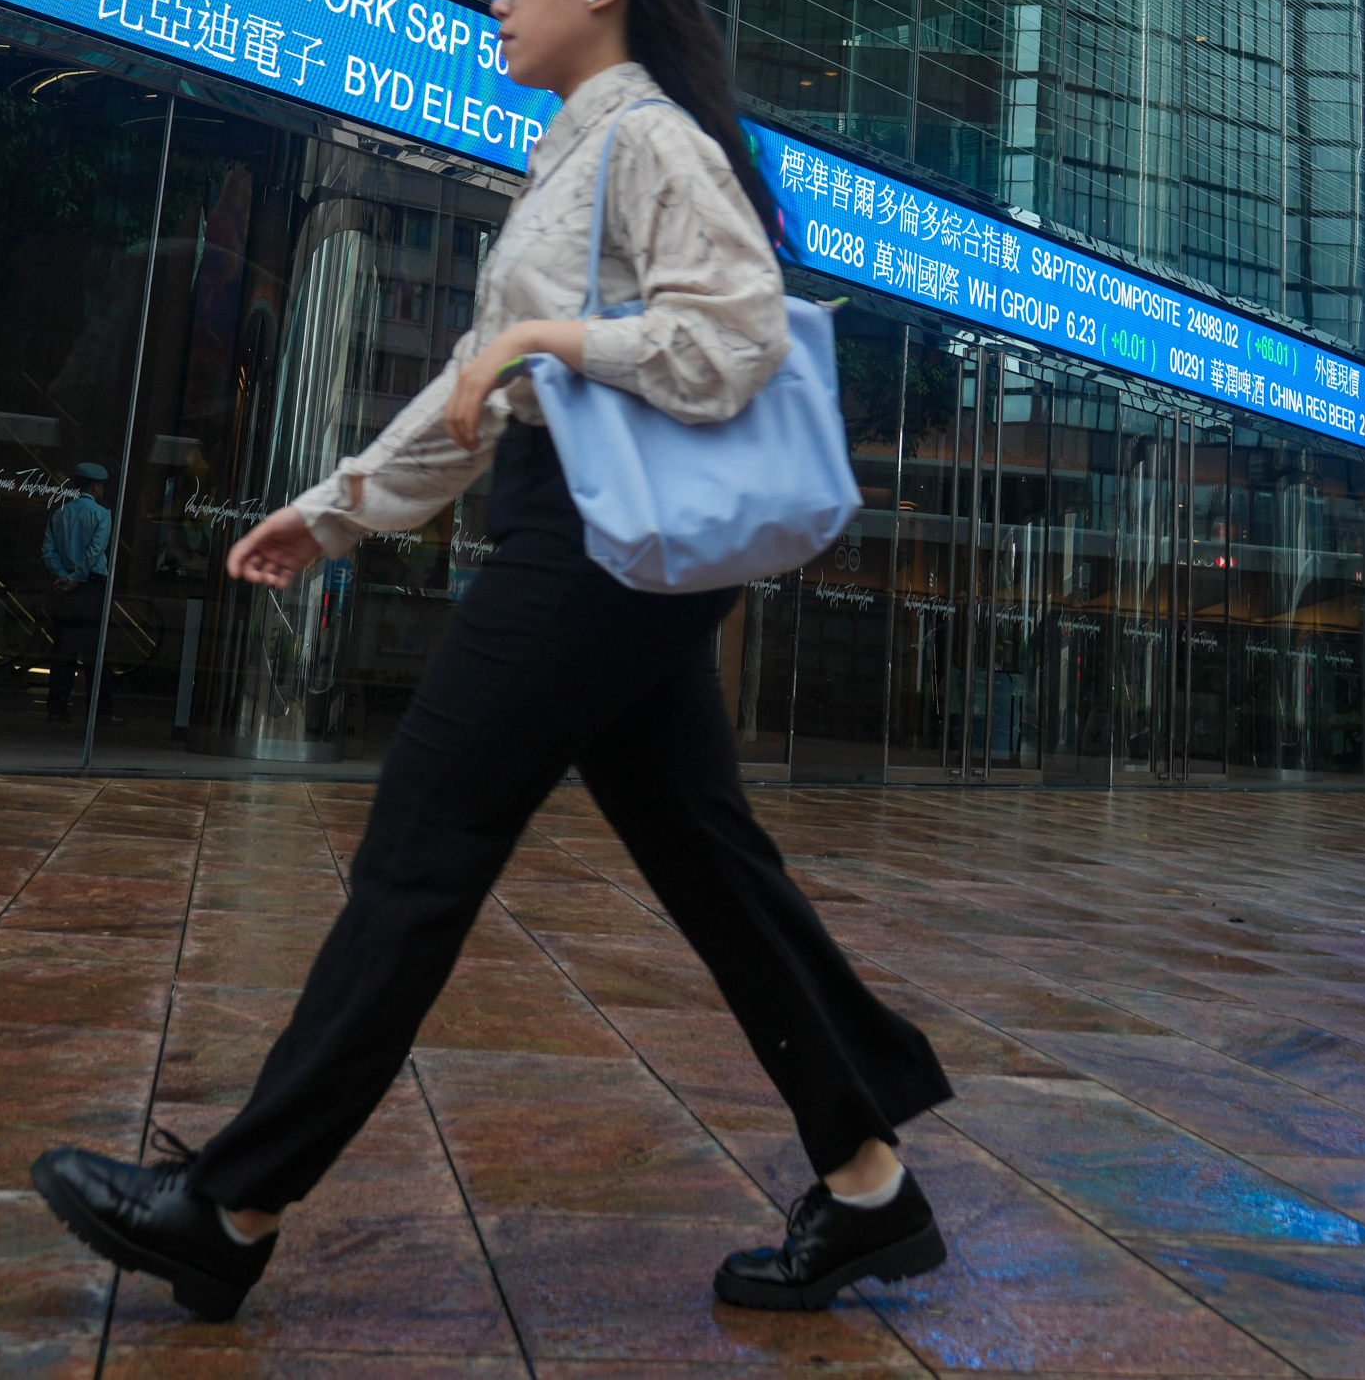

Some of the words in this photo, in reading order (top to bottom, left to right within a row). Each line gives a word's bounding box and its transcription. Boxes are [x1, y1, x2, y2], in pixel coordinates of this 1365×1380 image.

[344, 53, 415, 112] BYD
[405, 2, 471, 56] S&P
[778, 143, 1021, 275] 標準普爾多倫多綜合指數
[1031, 246, 1097, 297] S&P/TSX
[1099, 272, 1182, 329] COMPOSITE
[1186, 306, 1240, 349] 24989.02
[1254, 336, 1290, 367] +66.01
[1314, 352, 1361, 400] 外匯現價
[806, 219, 866, 270] 00288
[872, 238, 961, 306] 萬洲國際
[967, 275, 998, 313] WH
[1000, 287, 1061, 332] GROUP
[1065, 310, 1098, 347] 6.23
[1111, 329, 1147, 363] +0.01
[1169, 347, 1206, 382] 00291
[1210, 357, 1266, 408] 華潤啤酒
[1269, 381, 1304, 417] CHINA
[1305, 395, 1327, 424] RES
[1328, 405, 1356, 433] BEER
